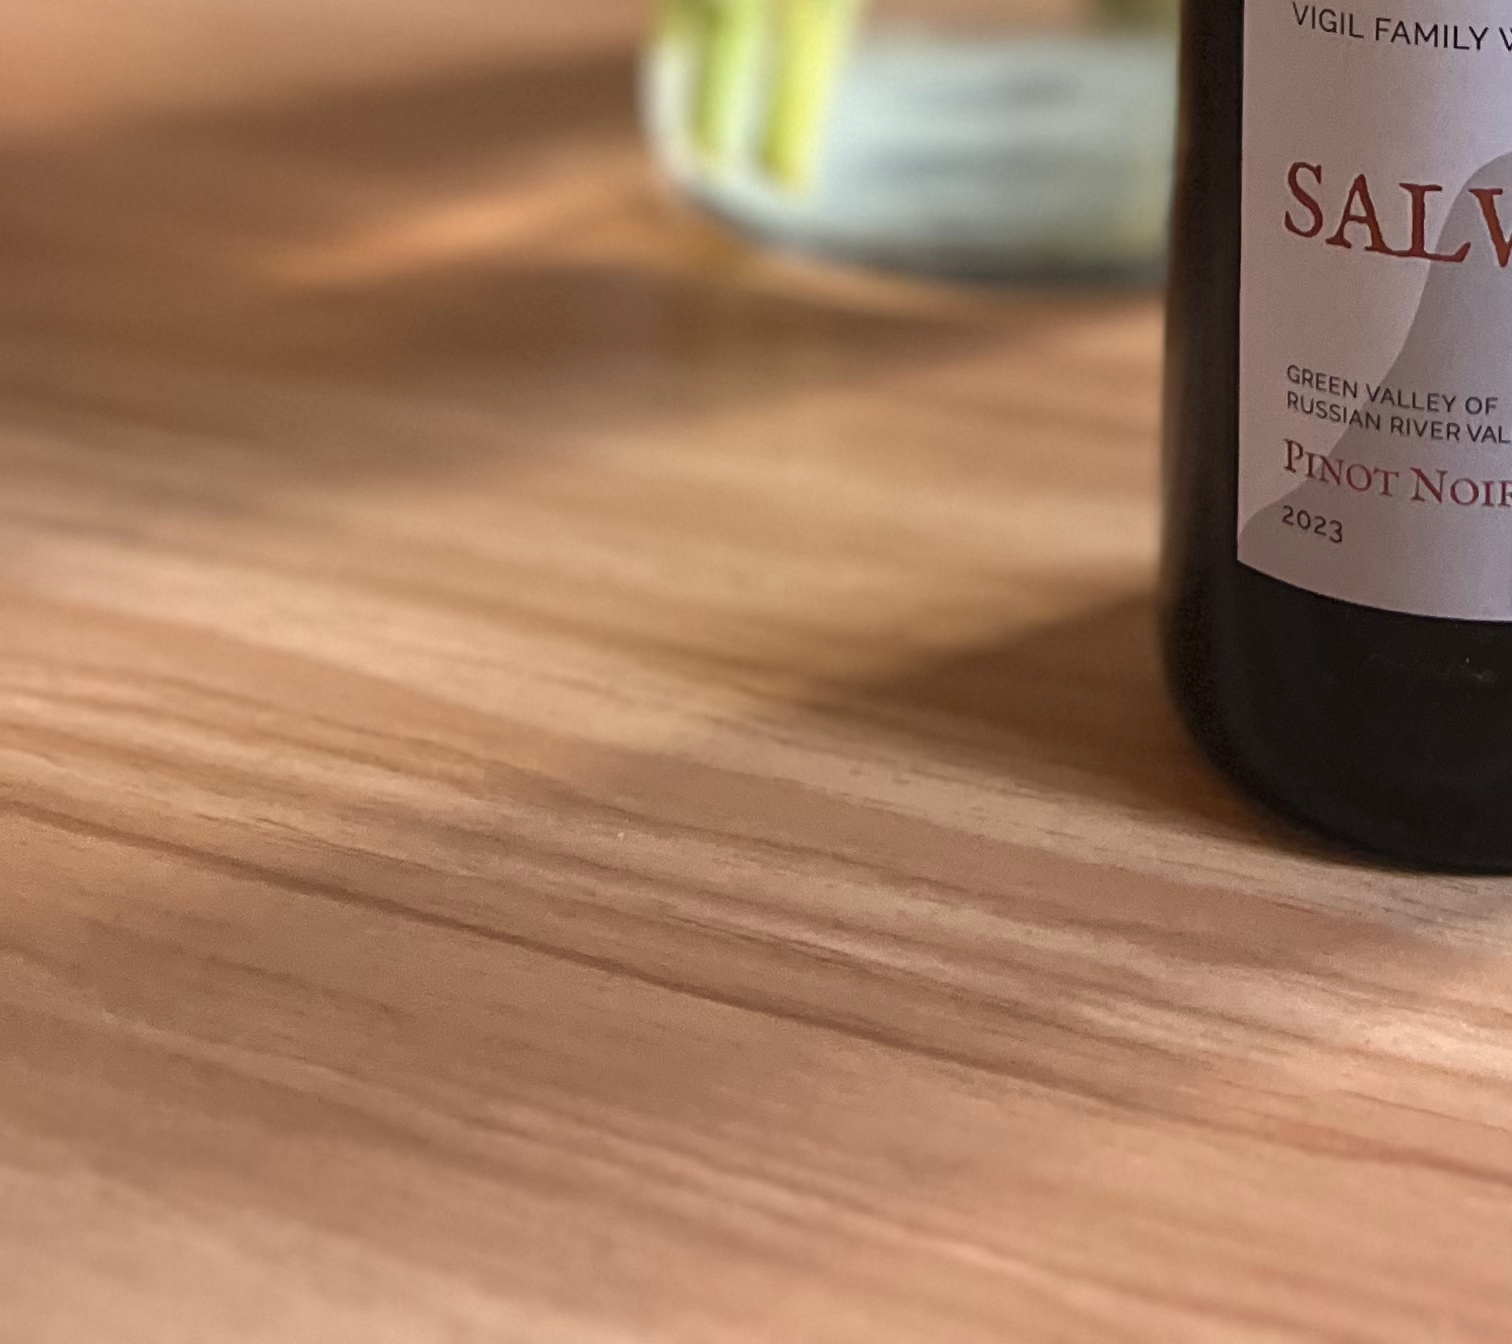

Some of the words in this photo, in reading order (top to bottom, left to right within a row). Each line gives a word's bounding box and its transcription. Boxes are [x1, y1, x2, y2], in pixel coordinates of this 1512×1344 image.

[1292, 1, 1364, 40] VIGIL
[1374, 17, 1490, 52] FAMILY
[1286, 364, 1359, 399] GREEN
[1364, 382, 1457, 416] VALLEY
[1465, 396, 1499, 416] OF
[1286, 390, 1381, 431] RUSSIAN
[1390, 416, 1461, 443] RIVER
[1283, 438, 1399, 500] PINOT
[1281, 504, 1344, 544] 2023
